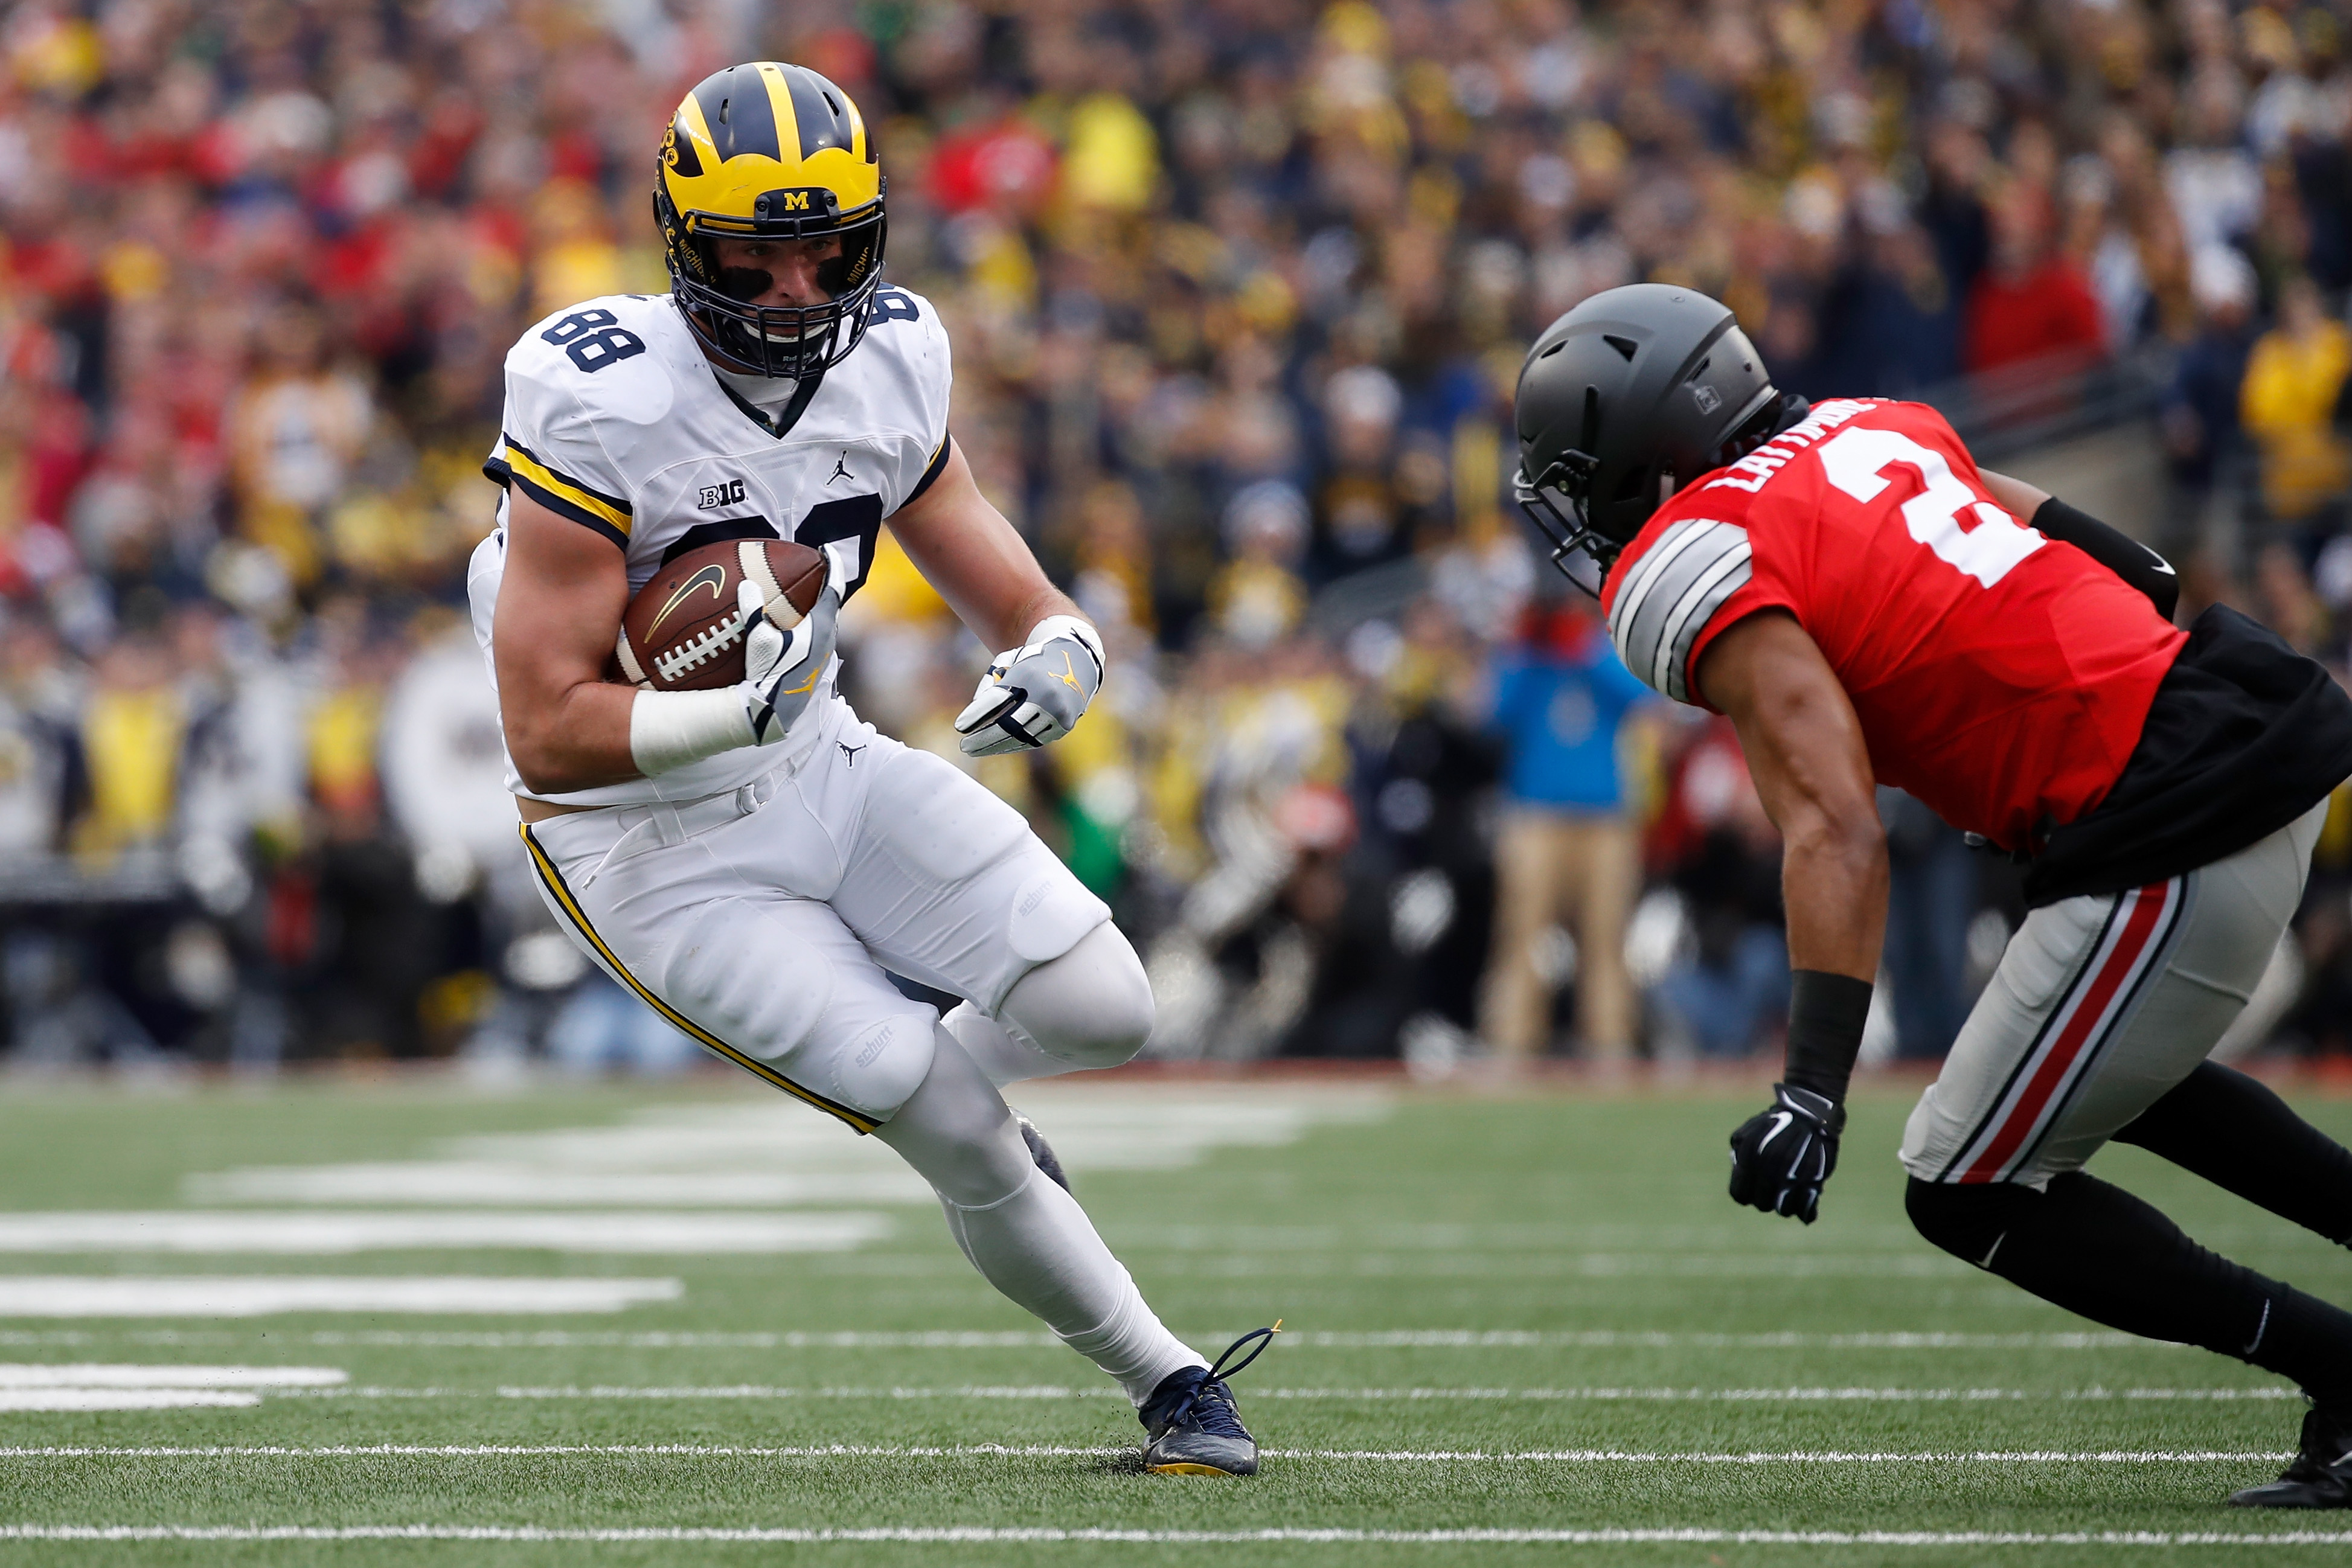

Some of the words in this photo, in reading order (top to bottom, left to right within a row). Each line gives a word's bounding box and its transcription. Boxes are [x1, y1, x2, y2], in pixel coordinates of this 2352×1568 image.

[784, 191, 809, 211] M
[541, 309, 647, 373] 88
[1817, 426, 2048, 589] 2
